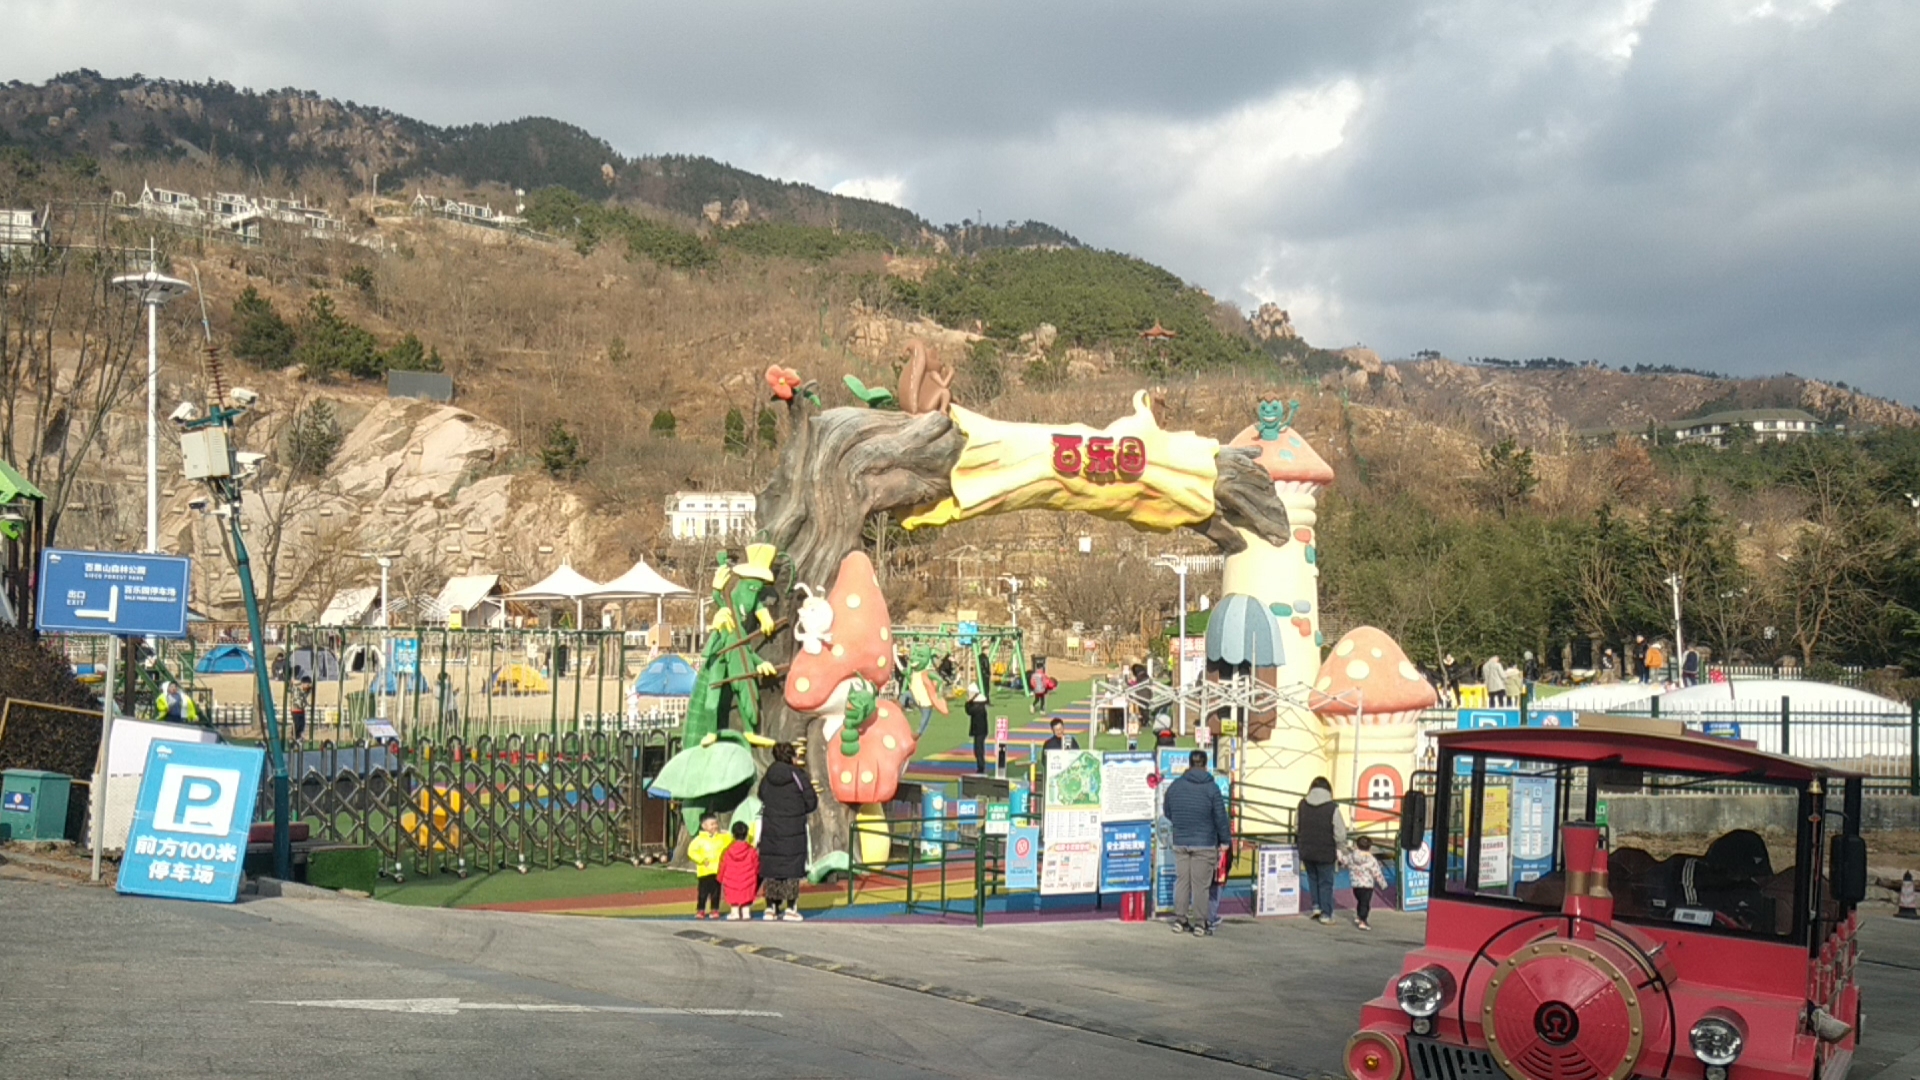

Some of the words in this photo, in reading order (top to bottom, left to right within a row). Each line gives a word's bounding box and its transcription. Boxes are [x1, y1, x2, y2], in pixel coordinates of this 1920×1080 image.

[1051, 433, 1146, 479] 百乐园
[67, 590, 86, 600] 出口
[124, 585, 177, 597] 百乐园停车场
[174, 775, 222, 824] P
[135, 834, 237, 862] 前方100米
[149, 859, 215, 884] 停车场
